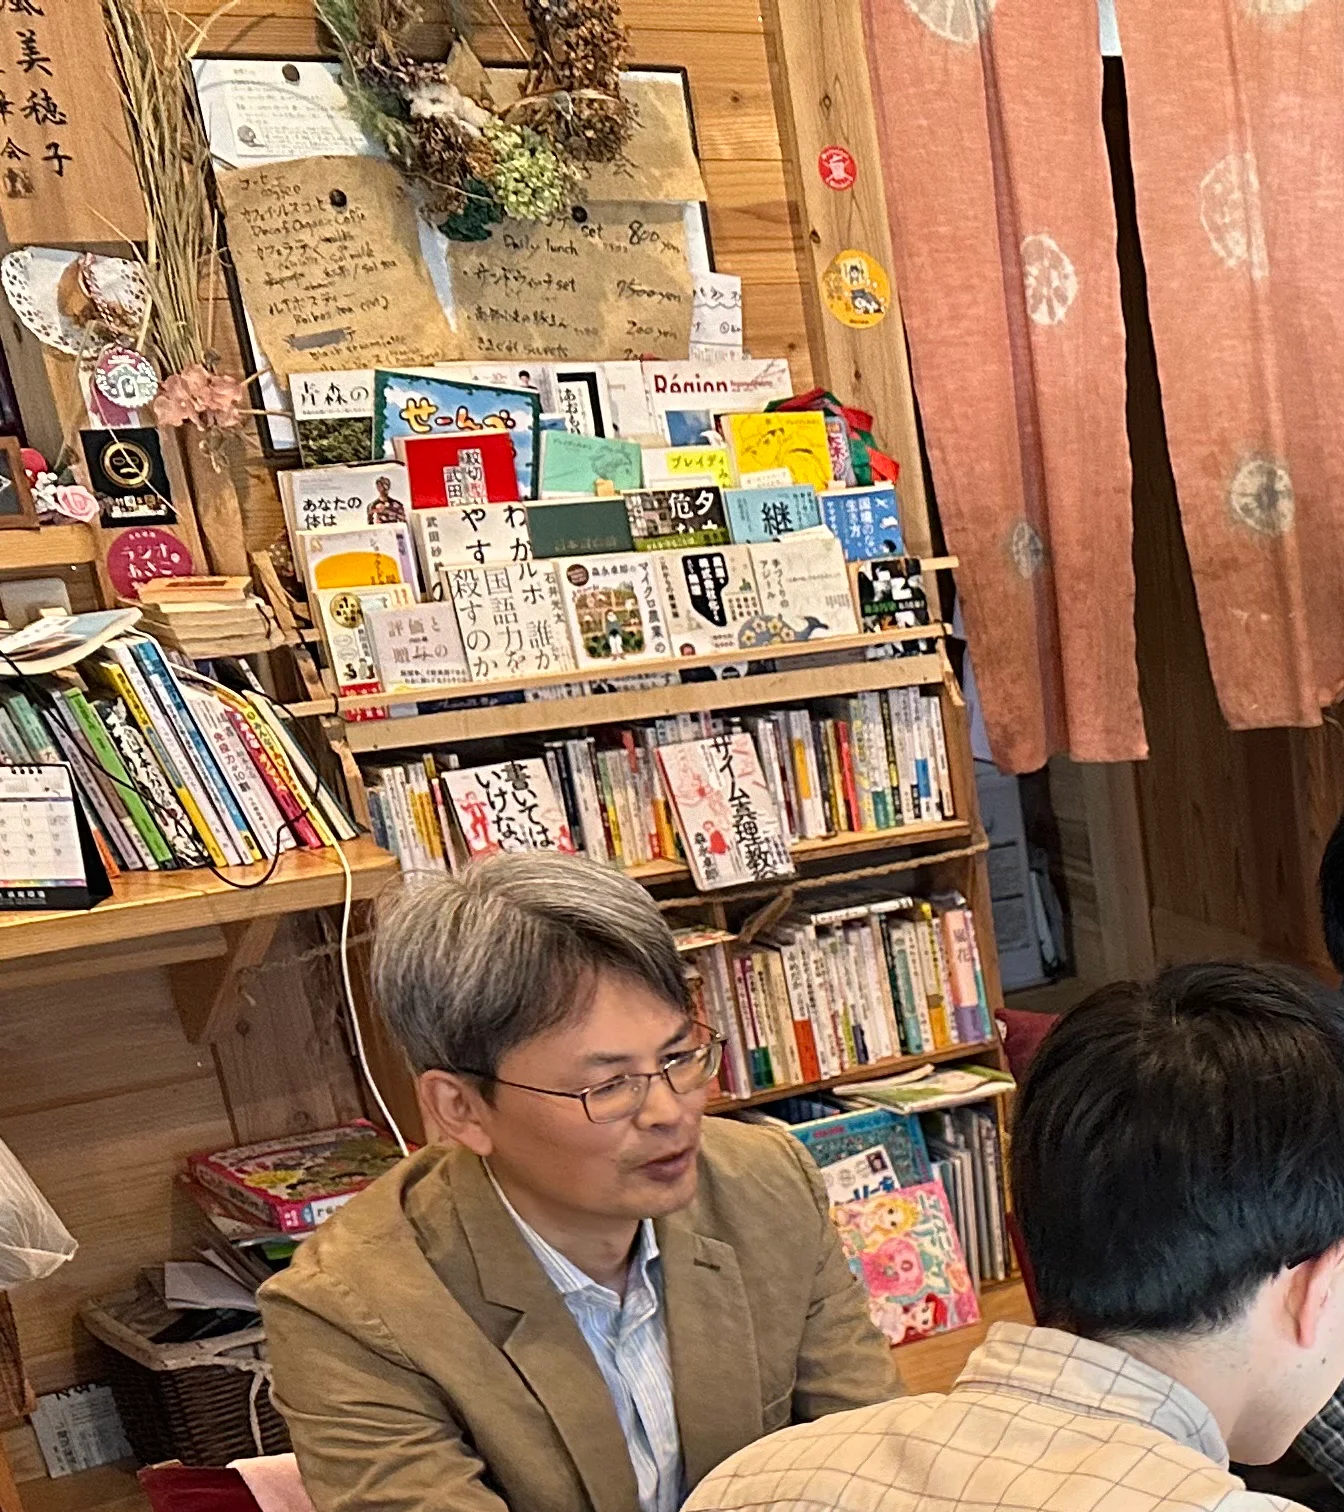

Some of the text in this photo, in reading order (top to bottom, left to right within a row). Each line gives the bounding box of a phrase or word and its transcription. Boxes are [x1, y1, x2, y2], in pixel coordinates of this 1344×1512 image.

[628, 220, 660, 245] 800
[301, 381, 369, 405] 青森の
[302, 496, 362, 513] あなたの
[519, 562, 544, 605] ルポ
[453, 568, 498, 677] 殺すのか
[484, 567, 526, 673] 国語力を
[501, 759, 555, 848] 書いては
